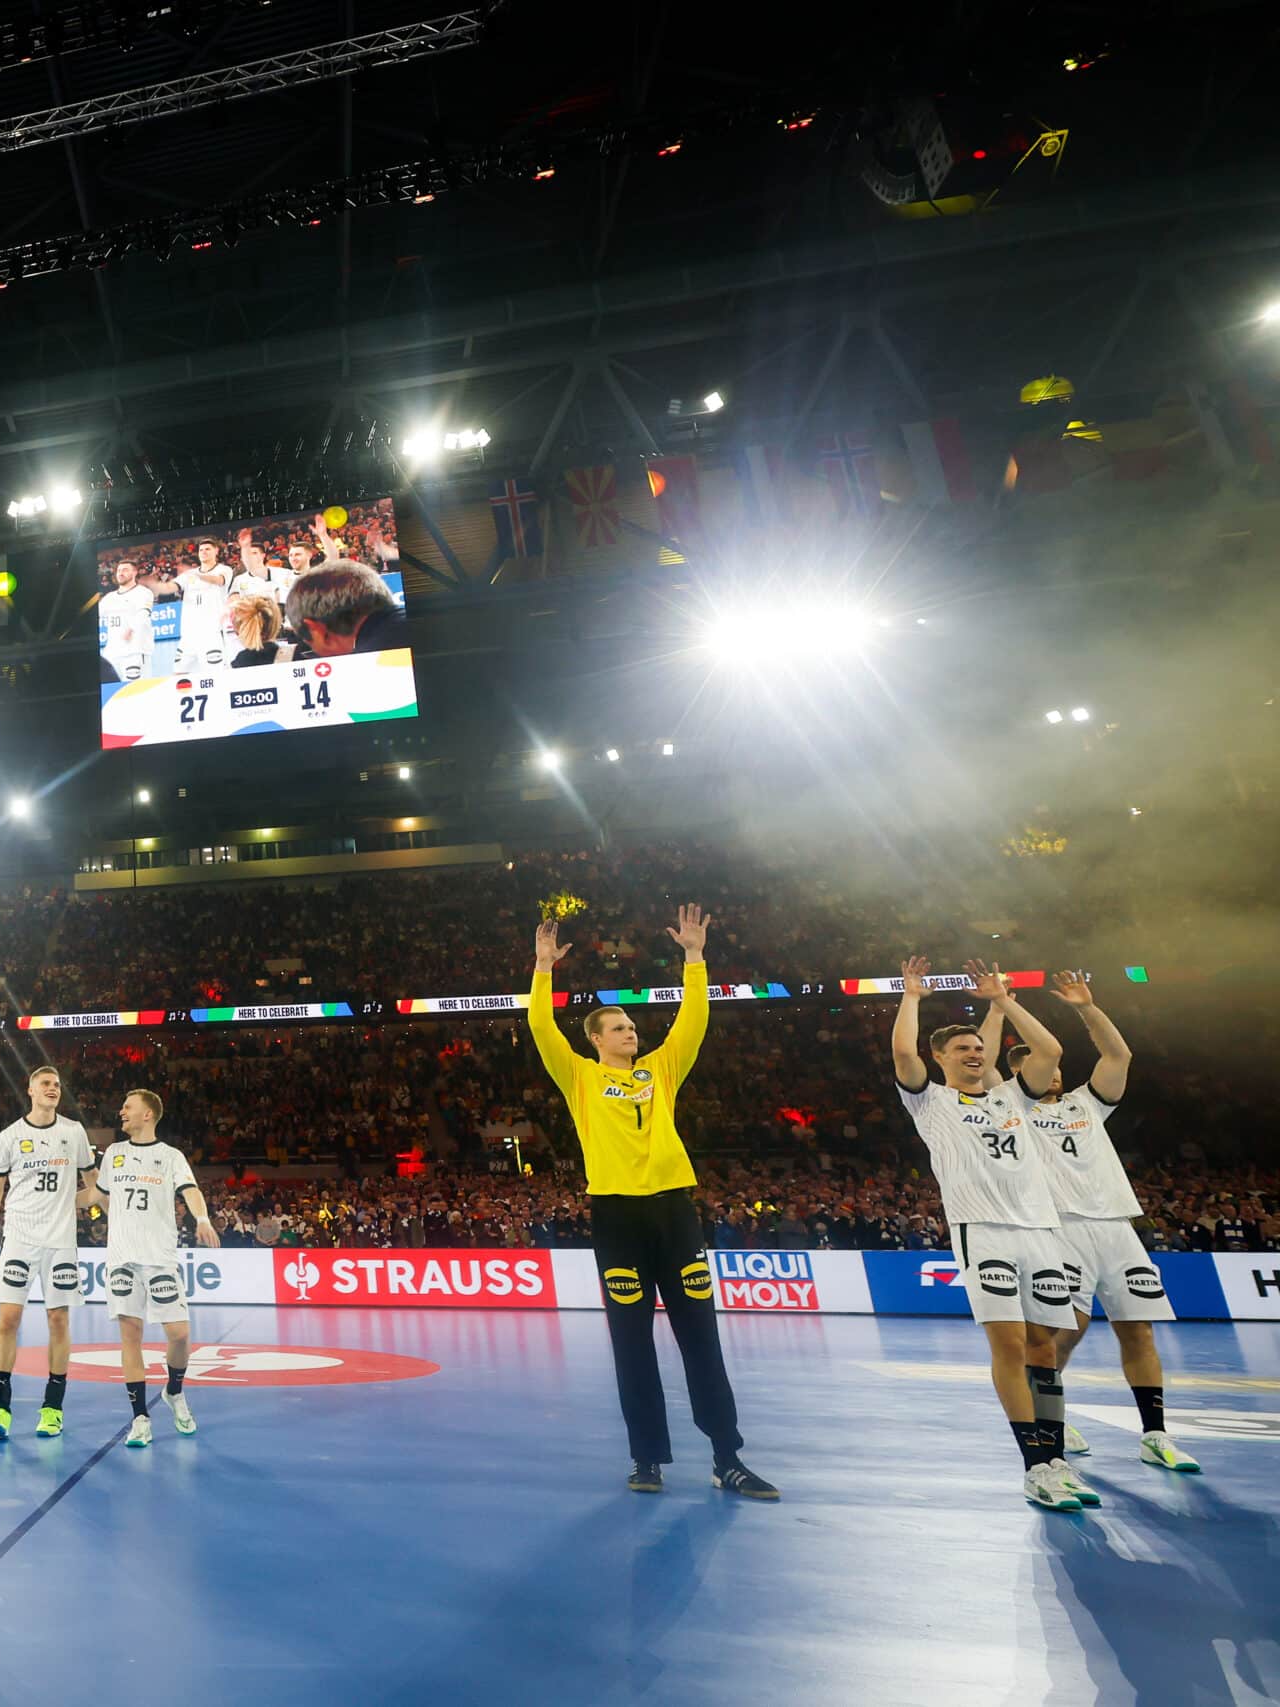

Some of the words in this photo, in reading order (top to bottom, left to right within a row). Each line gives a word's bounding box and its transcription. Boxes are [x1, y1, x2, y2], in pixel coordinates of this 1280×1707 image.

[293, 668, 306, 678] SUI
[200, 678, 214, 689] GER
[234, 692, 274, 705] 30:00
[300, 680, 331, 710] 14
[180, 694, 209, 723] 27
[438, 999, 457, 1010] HERE
[460, 999, 470, 1009] TO
[472, 996, 514, 1009] CELEBRATE
[655, 989, 675, 1001] HERE
[53, 1016, 71, 1026] HERE
[72, 1016, 81, 1025] TO
[81, 1014, 119, 1025] CELEBRATE
[238, 1008, 257, 1018] HERE
[258, 1008, 268, 1017] TO
[269, 1006, 309, 1017] CELEBRATE
[634, 1104, 642, 1129] 1
[981, 1132, 1019, 1160] 34
[1061, 1135, 1078, 1157] 4
[23, 1159, 70, 1170] AUTOHERO
[34, 1171, 58, 1192] 38
[114, 1175, 163, 1185] AUTOHERO
[124, 1188, 149, 1211] 73
[718, 1252, 810, 1280] LIQUI
[331, 1258, 544, 1296] STRAUSS
[607, 1280, 642, 1290] HARTING
[723, 1282, 814, 1308] MOLY
